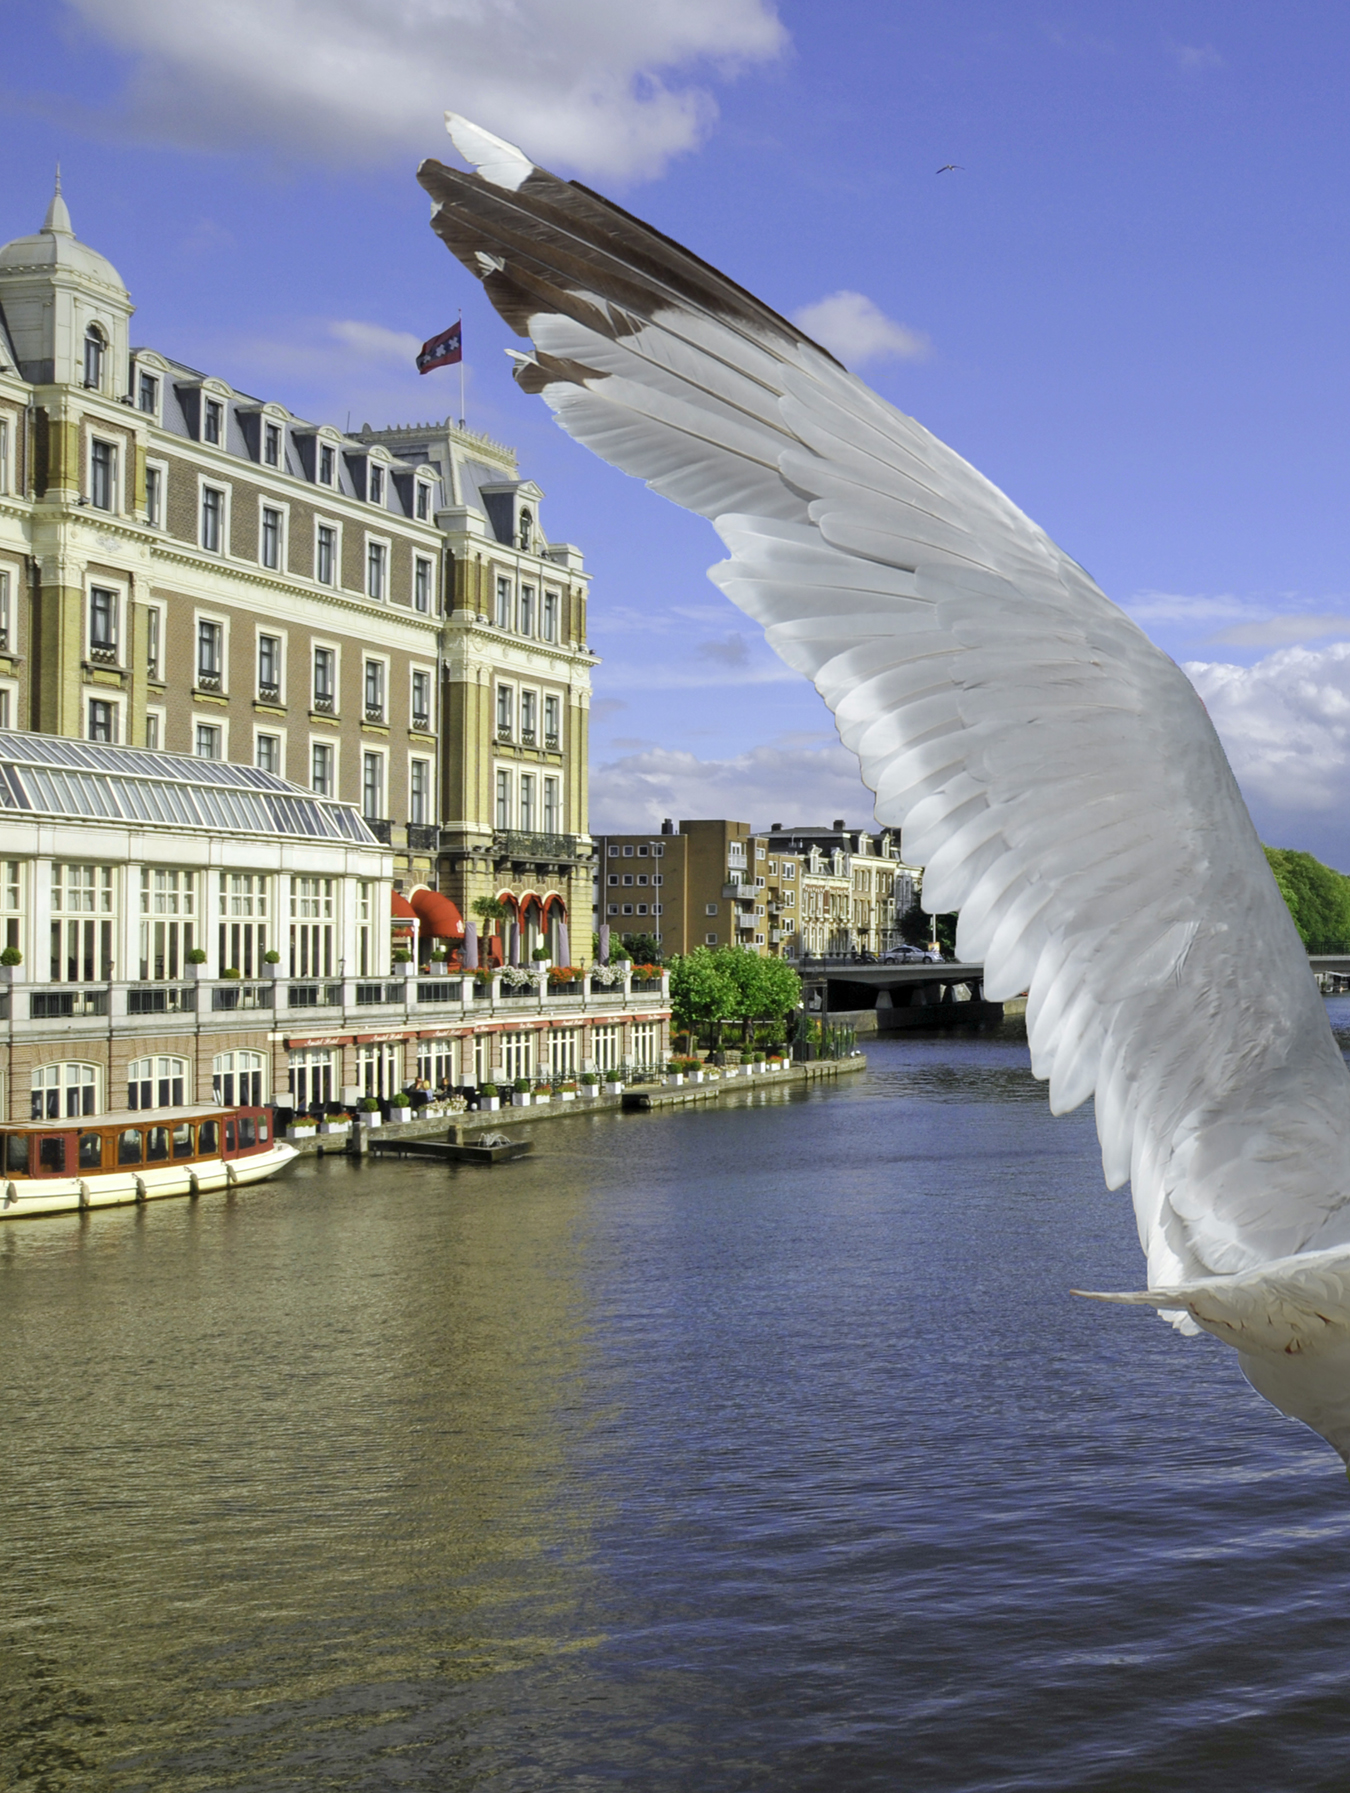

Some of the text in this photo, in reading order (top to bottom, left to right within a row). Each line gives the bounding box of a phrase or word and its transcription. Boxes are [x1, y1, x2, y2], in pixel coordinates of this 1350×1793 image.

[304, 1037, 340, 1046] Amstel Hotel
[370, 1032, 404, 1042] Amstel Hotel
